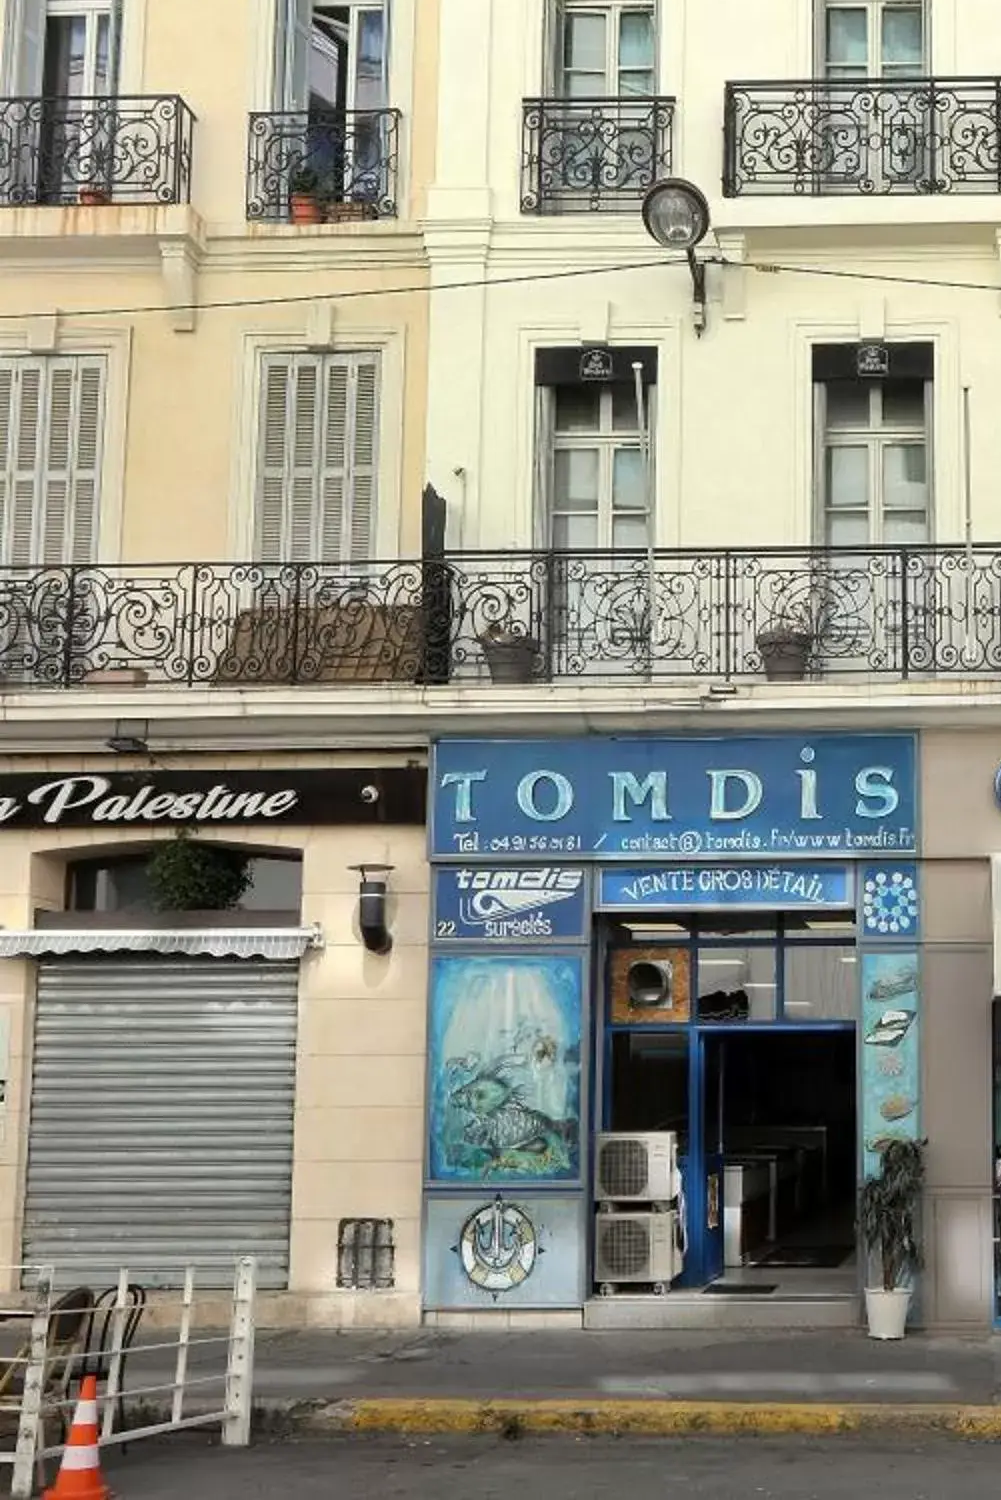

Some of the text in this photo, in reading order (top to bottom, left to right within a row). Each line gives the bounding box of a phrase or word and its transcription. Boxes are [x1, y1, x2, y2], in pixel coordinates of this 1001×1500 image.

[27, 775, 299, 823] Palestine
[456, 867, 583, 890] tomdis
[622, 870, 694, 901] VENTE
[437, 921, 457, 937] 22
